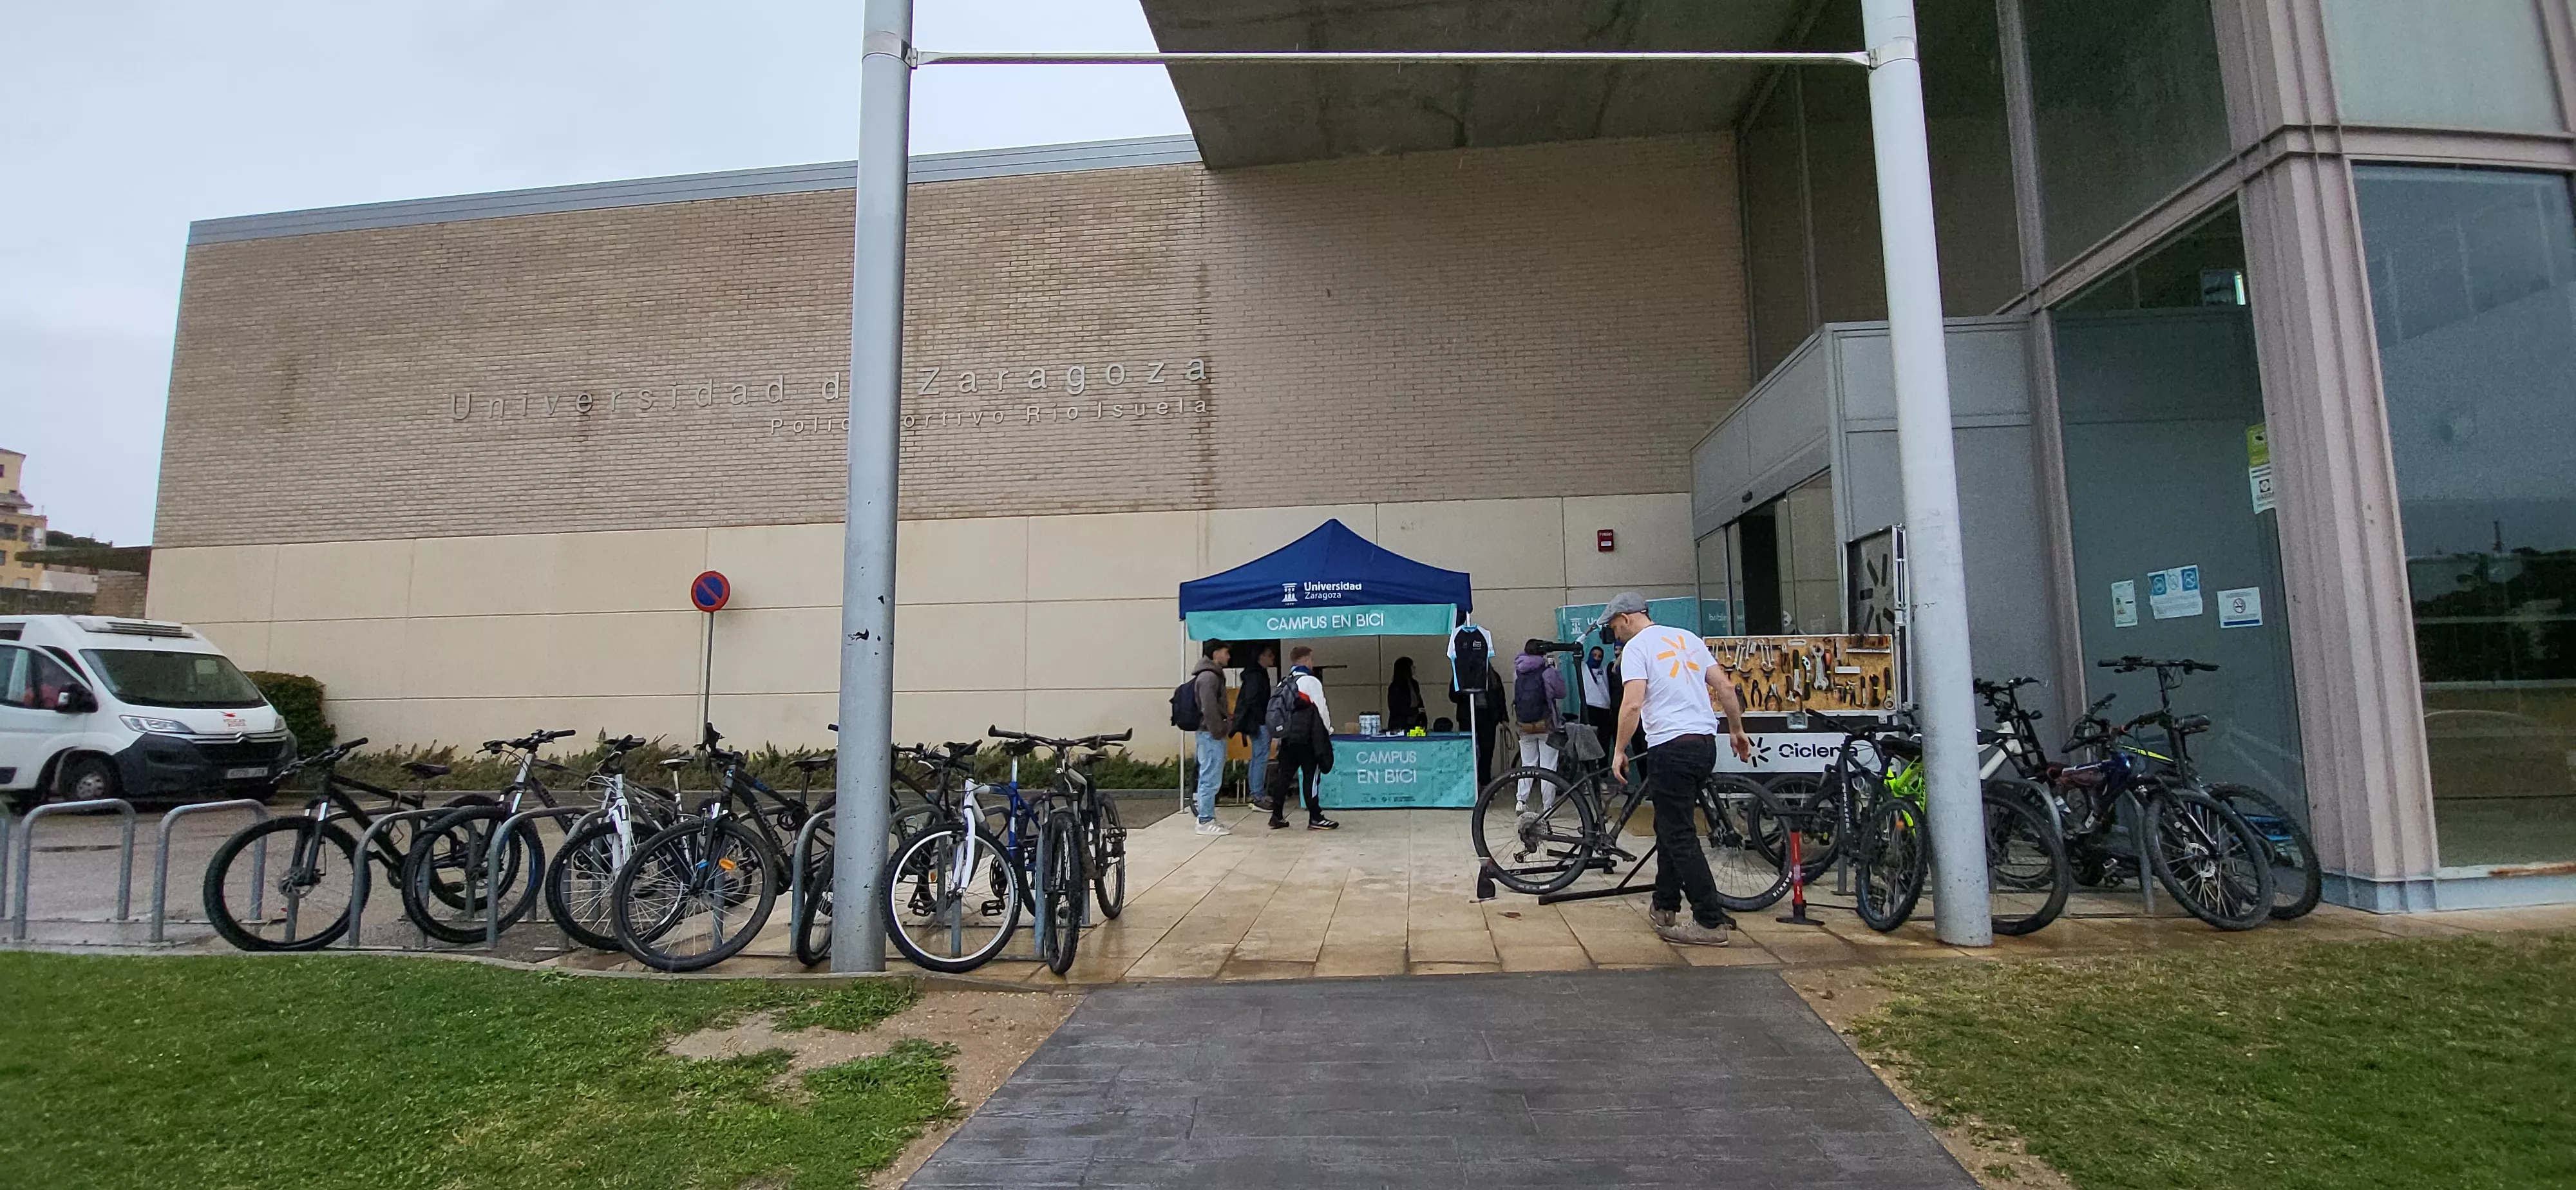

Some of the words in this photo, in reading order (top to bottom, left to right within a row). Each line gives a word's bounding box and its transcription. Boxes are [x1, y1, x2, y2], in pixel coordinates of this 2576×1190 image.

[451, 375, 785, 420] Universidad
[822, 372, 840, 400] d
[917, 357, 1207, 397] Zaragoza
[771, 410, 1005, 435] Poliortivo
[1097, 397, 1208, 419] Isuela
[1303, 581, 1362, 591] Universidad
[1304, 591, 1341, 601] Zaragoza
[1266, 616, 1327, 630] CAMPUS
[1332, 614, 1351, 628] EN
[1356, 612, 1384, 627] BICI
[1356, 750, 1417, 764] CAMPUS
[1357, 769, 1379, 784] EN
[1384, 768, 1417, 784] BICI
